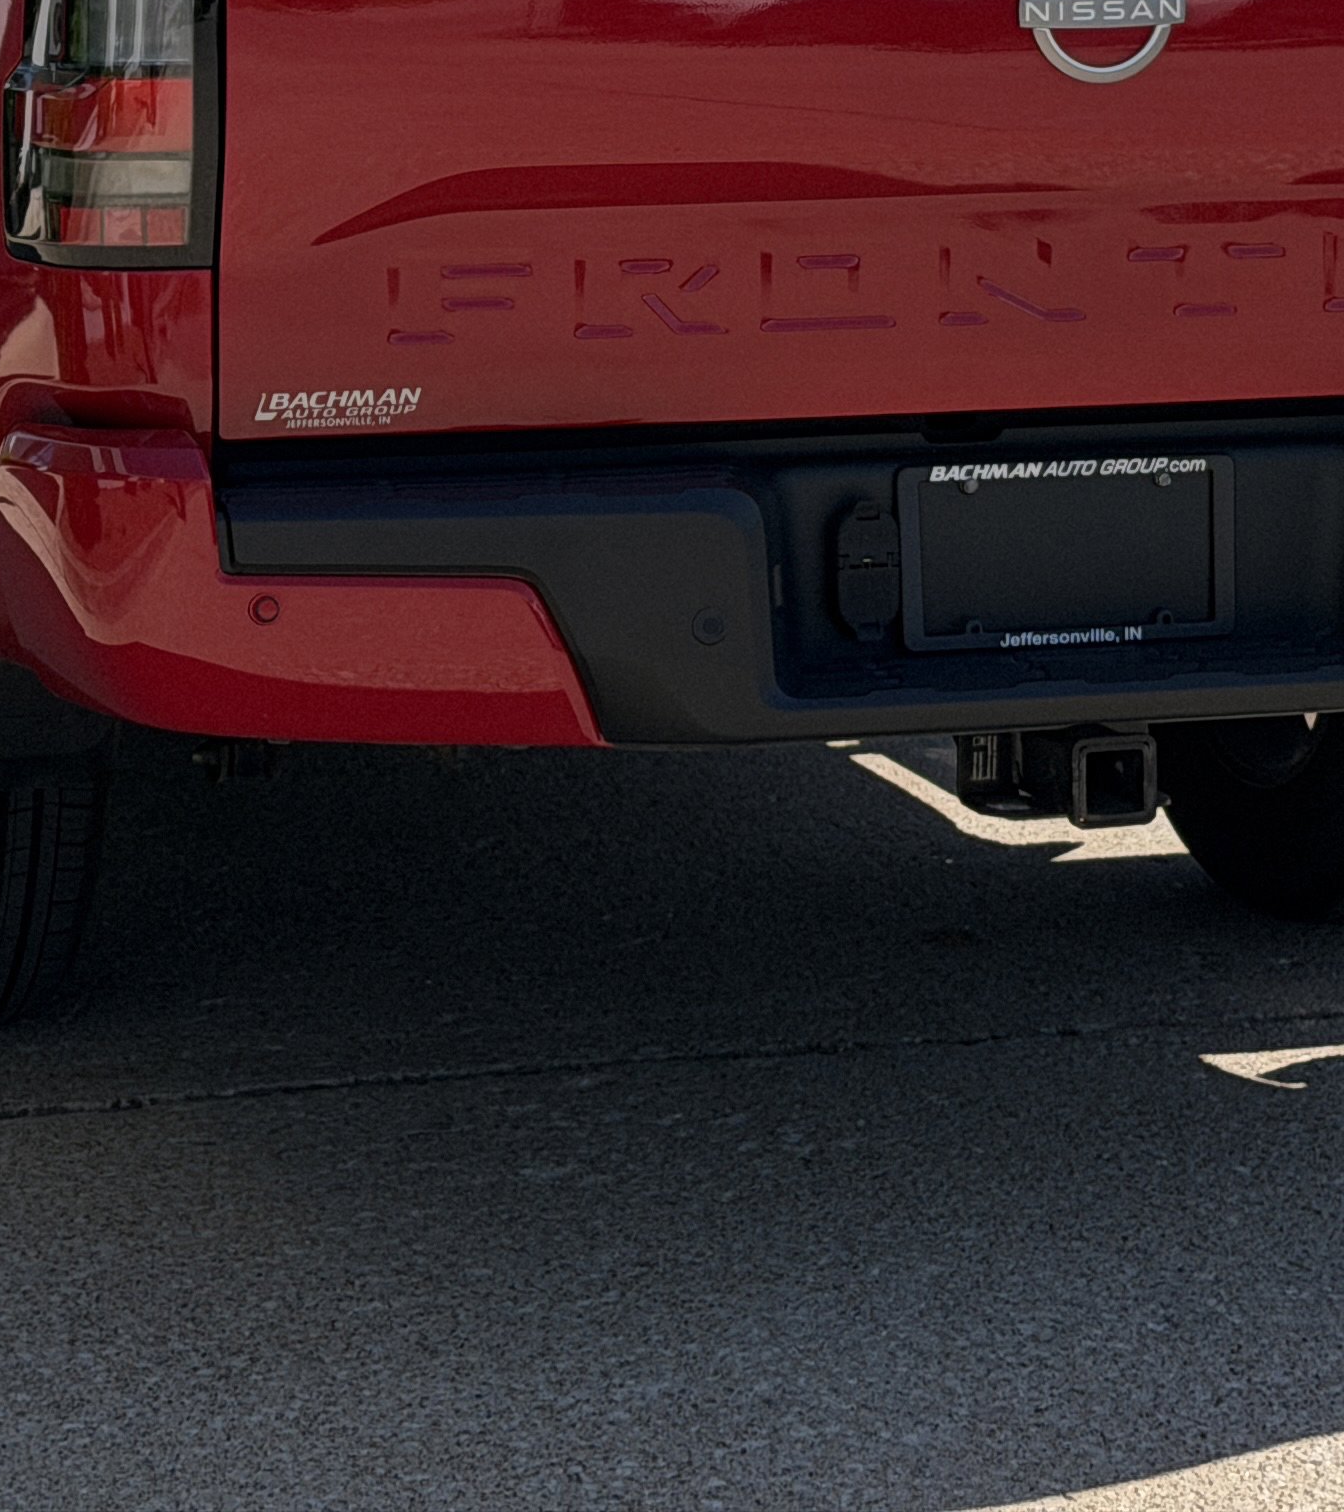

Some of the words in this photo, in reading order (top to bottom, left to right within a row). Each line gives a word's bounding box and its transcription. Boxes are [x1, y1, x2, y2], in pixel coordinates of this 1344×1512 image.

[269, 387, 422, 410] BACHMAN
[281, 407, 337, 420] AUTO
[346, 404, 416, 417] GROUP
[286, 416, 376, 429] JEFFERSONVILLE,
[378, 415, 391, 426] IN
[930, 462, 1043, 482] BACHMAN
[1043, 459, 1097, 478] AUTO
[1099, 457, 1206, 476] GROUP.com
[1000, 627, 1120, 649] Jeffersonville,
[1124, 625, 1142, 641] IN
